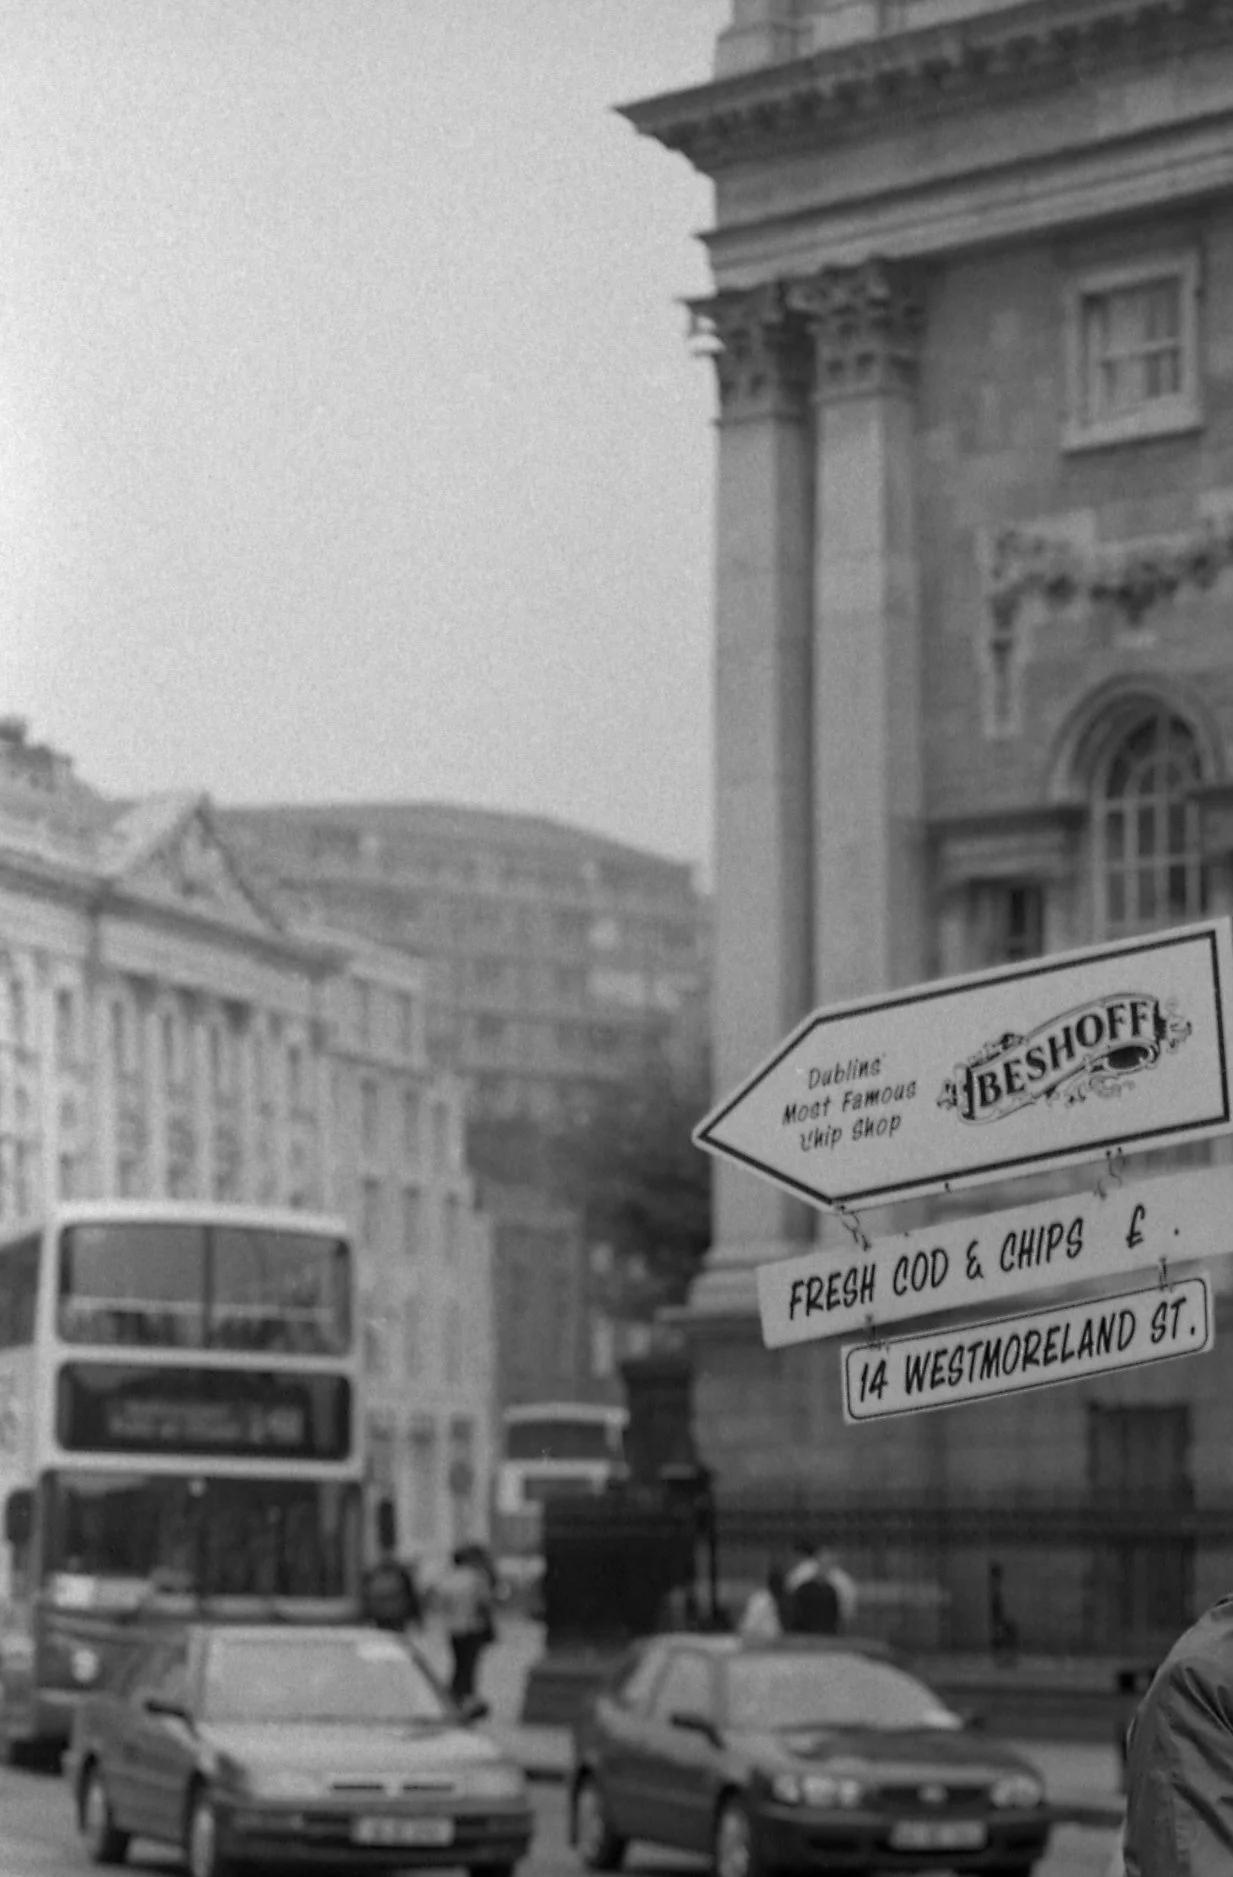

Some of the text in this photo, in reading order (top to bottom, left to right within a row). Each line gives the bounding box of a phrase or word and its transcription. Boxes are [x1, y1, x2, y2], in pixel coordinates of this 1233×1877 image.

[781, 1080, 917, 1126] Most Famous
[976, 1001, 1148, 1108] BESHOFF
[851, 1114, 902, 1141] Shop
[789, 1263, 877, 1321] FRESH
[893, 1248, 949, 1297] COD
[966, 1239, 985, 1280] &
[1000, 1216, 1085, 1273] CHIPS
[860, 1297, 1197, 1403] 14 WESTMORELAND ST.
